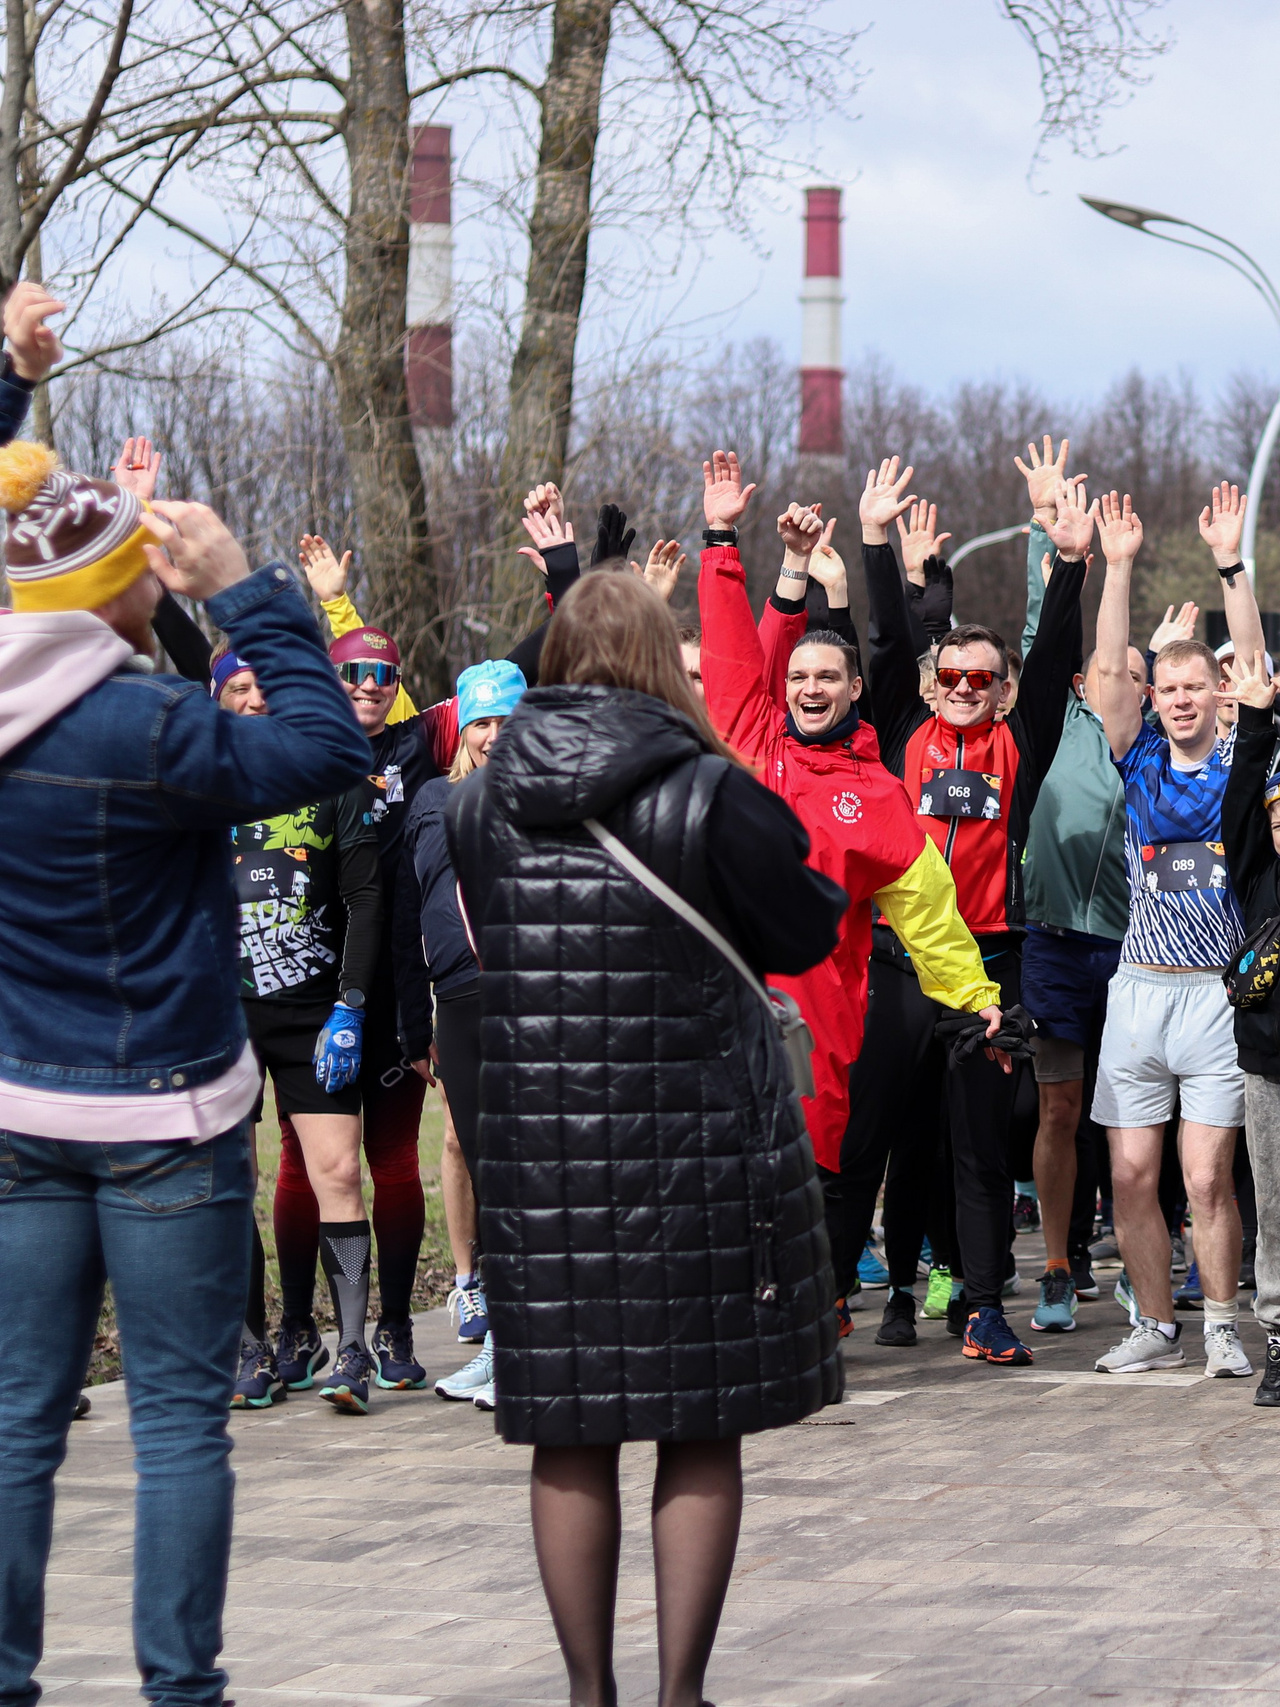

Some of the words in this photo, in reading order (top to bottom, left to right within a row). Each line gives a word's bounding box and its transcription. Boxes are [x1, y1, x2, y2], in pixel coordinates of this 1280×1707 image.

[948, 785, 971, 798] 068
[1172, 858, 1196, 872] 089
[250, 867, 276, 883] 052
